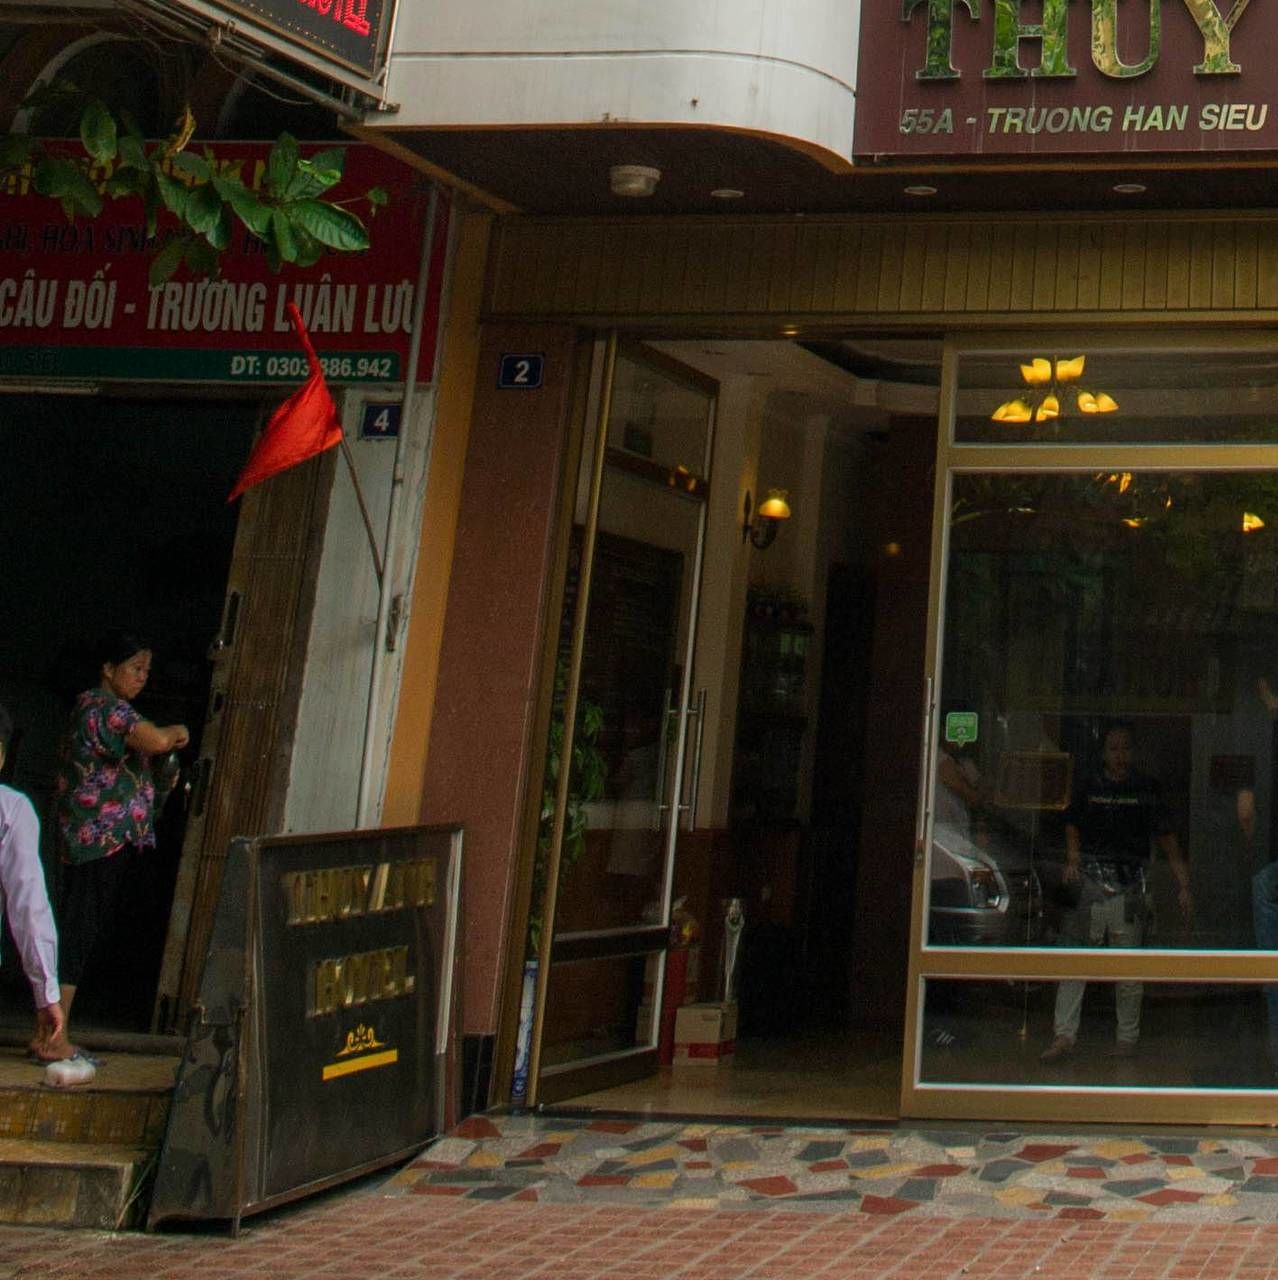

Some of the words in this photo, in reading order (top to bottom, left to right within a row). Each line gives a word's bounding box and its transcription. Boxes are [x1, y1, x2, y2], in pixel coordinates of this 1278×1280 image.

[899, 108, 955, 135] 55A
[987, 105, 1113, 135] TRUONG
[1121, 104, 1190, 132] HAN
[1199, 103, 1268, 131] SIEU
[0, 266, 58, 329] CÂU
[63, 261, 119, 329] ĐỐI
[230, 355, 262, 376] ĐT:
[513, 360, 531, 383] 2
[373, 408, 390, 432] 4
